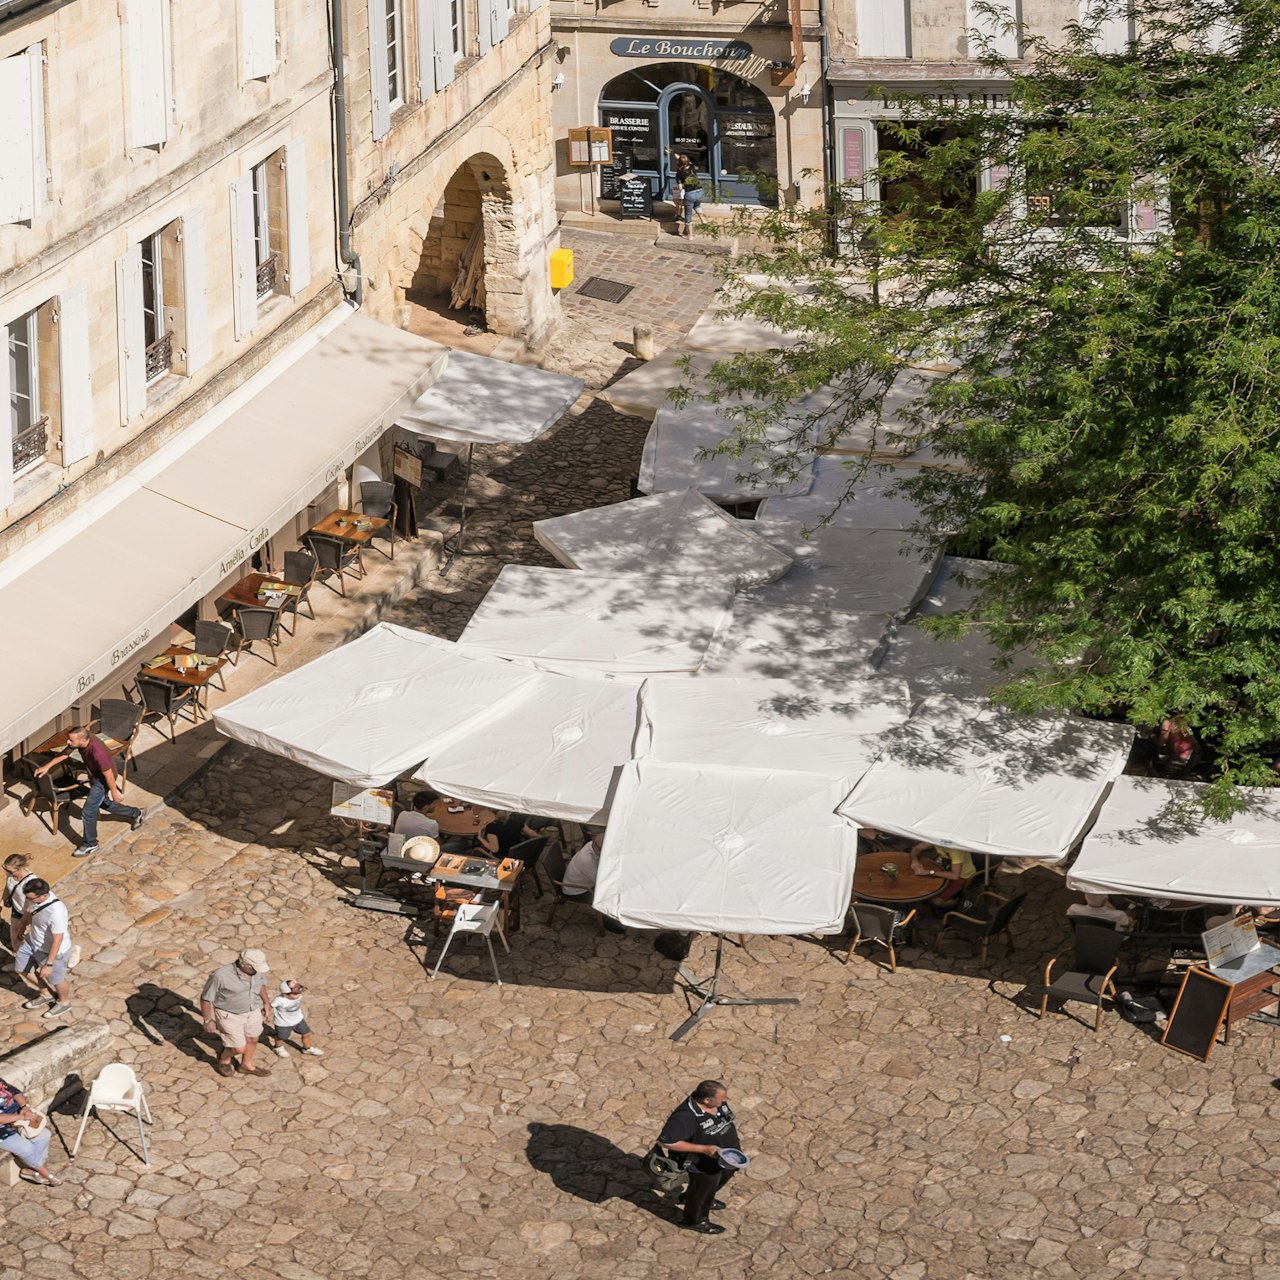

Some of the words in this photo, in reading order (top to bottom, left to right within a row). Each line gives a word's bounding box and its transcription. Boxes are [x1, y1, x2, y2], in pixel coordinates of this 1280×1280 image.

[626, 40, 650, 55] Le
[655, 40, 737, 57] Bouchon
[610, 117, 650, 126] BRASSERIE
[726, 122, 767, 130] RESTAURANT
[76, 673, 95, 694] Bar
